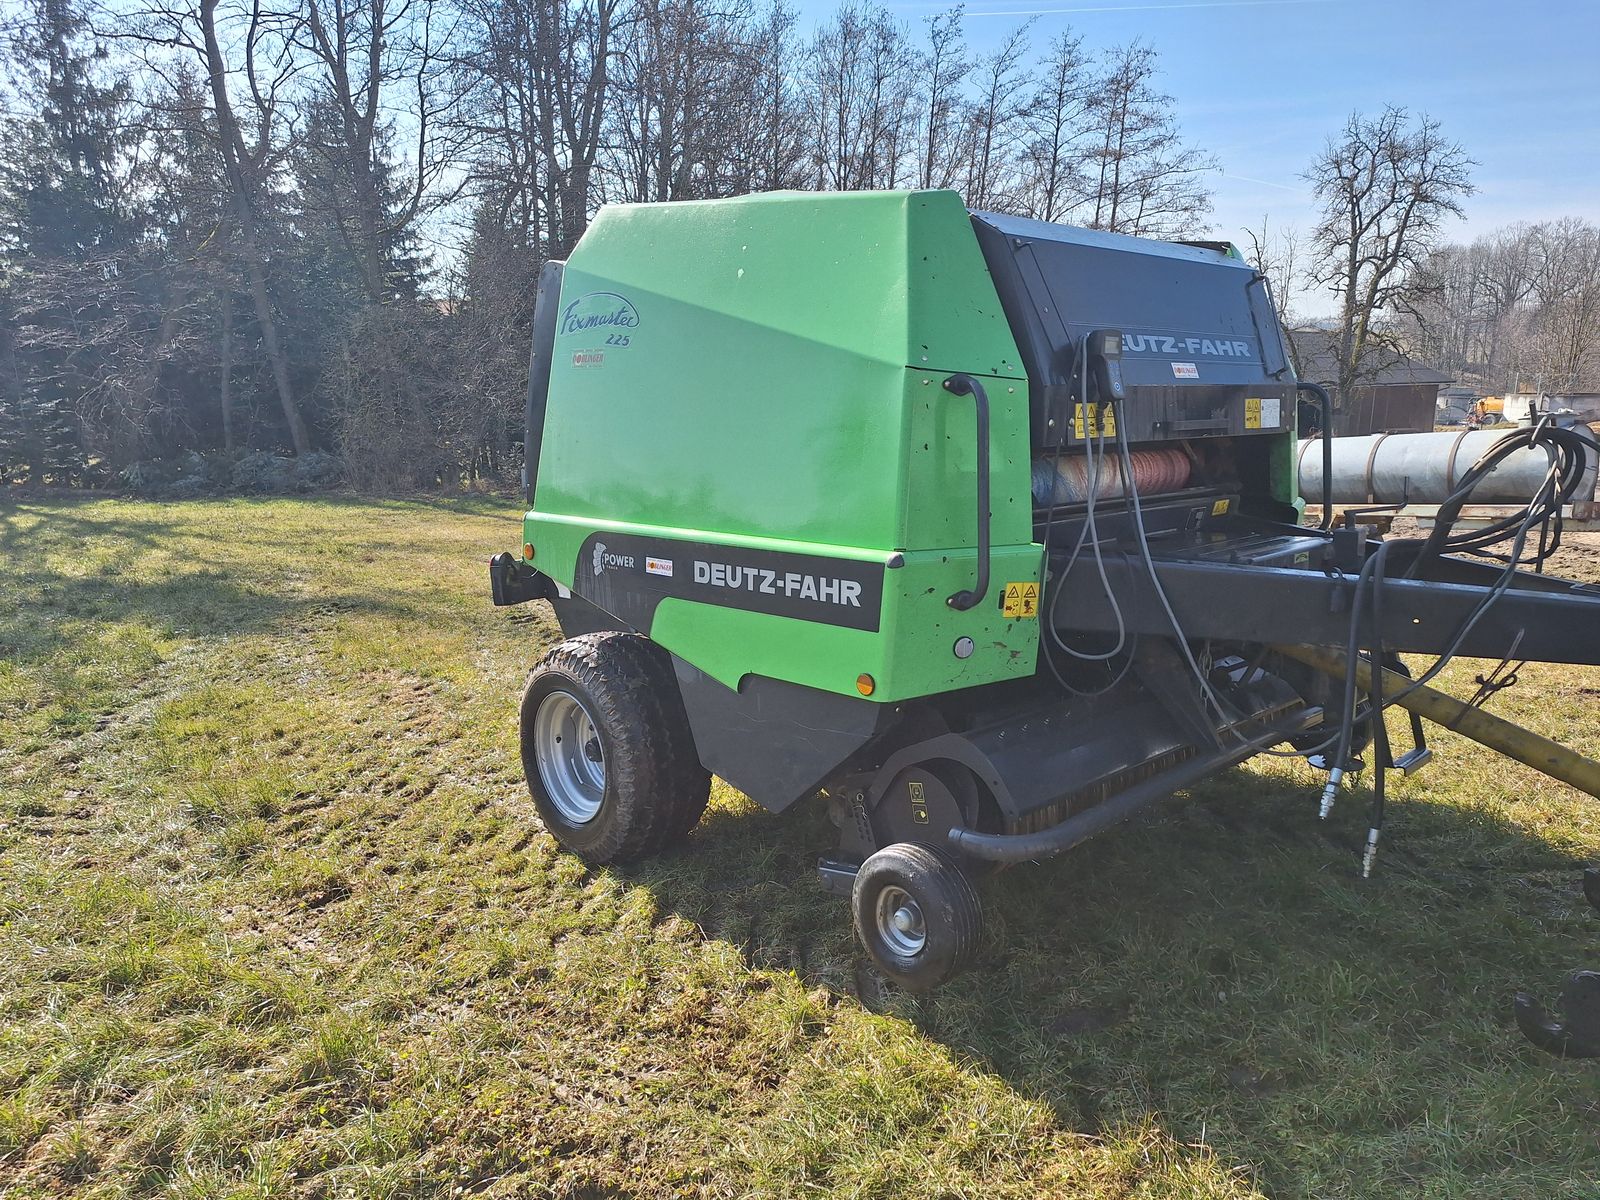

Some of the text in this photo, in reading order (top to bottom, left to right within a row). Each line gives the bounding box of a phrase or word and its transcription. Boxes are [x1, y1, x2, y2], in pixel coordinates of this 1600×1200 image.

[561, 299, 640, 335] Fixmaster
[605, 333, 630, 346] 225
[1121, 334, 1250, 357] UTZ-FAHR
[604, 553, 634, 568] POWER
[694, 560, 862, 607] DEUTZ-FAHR
